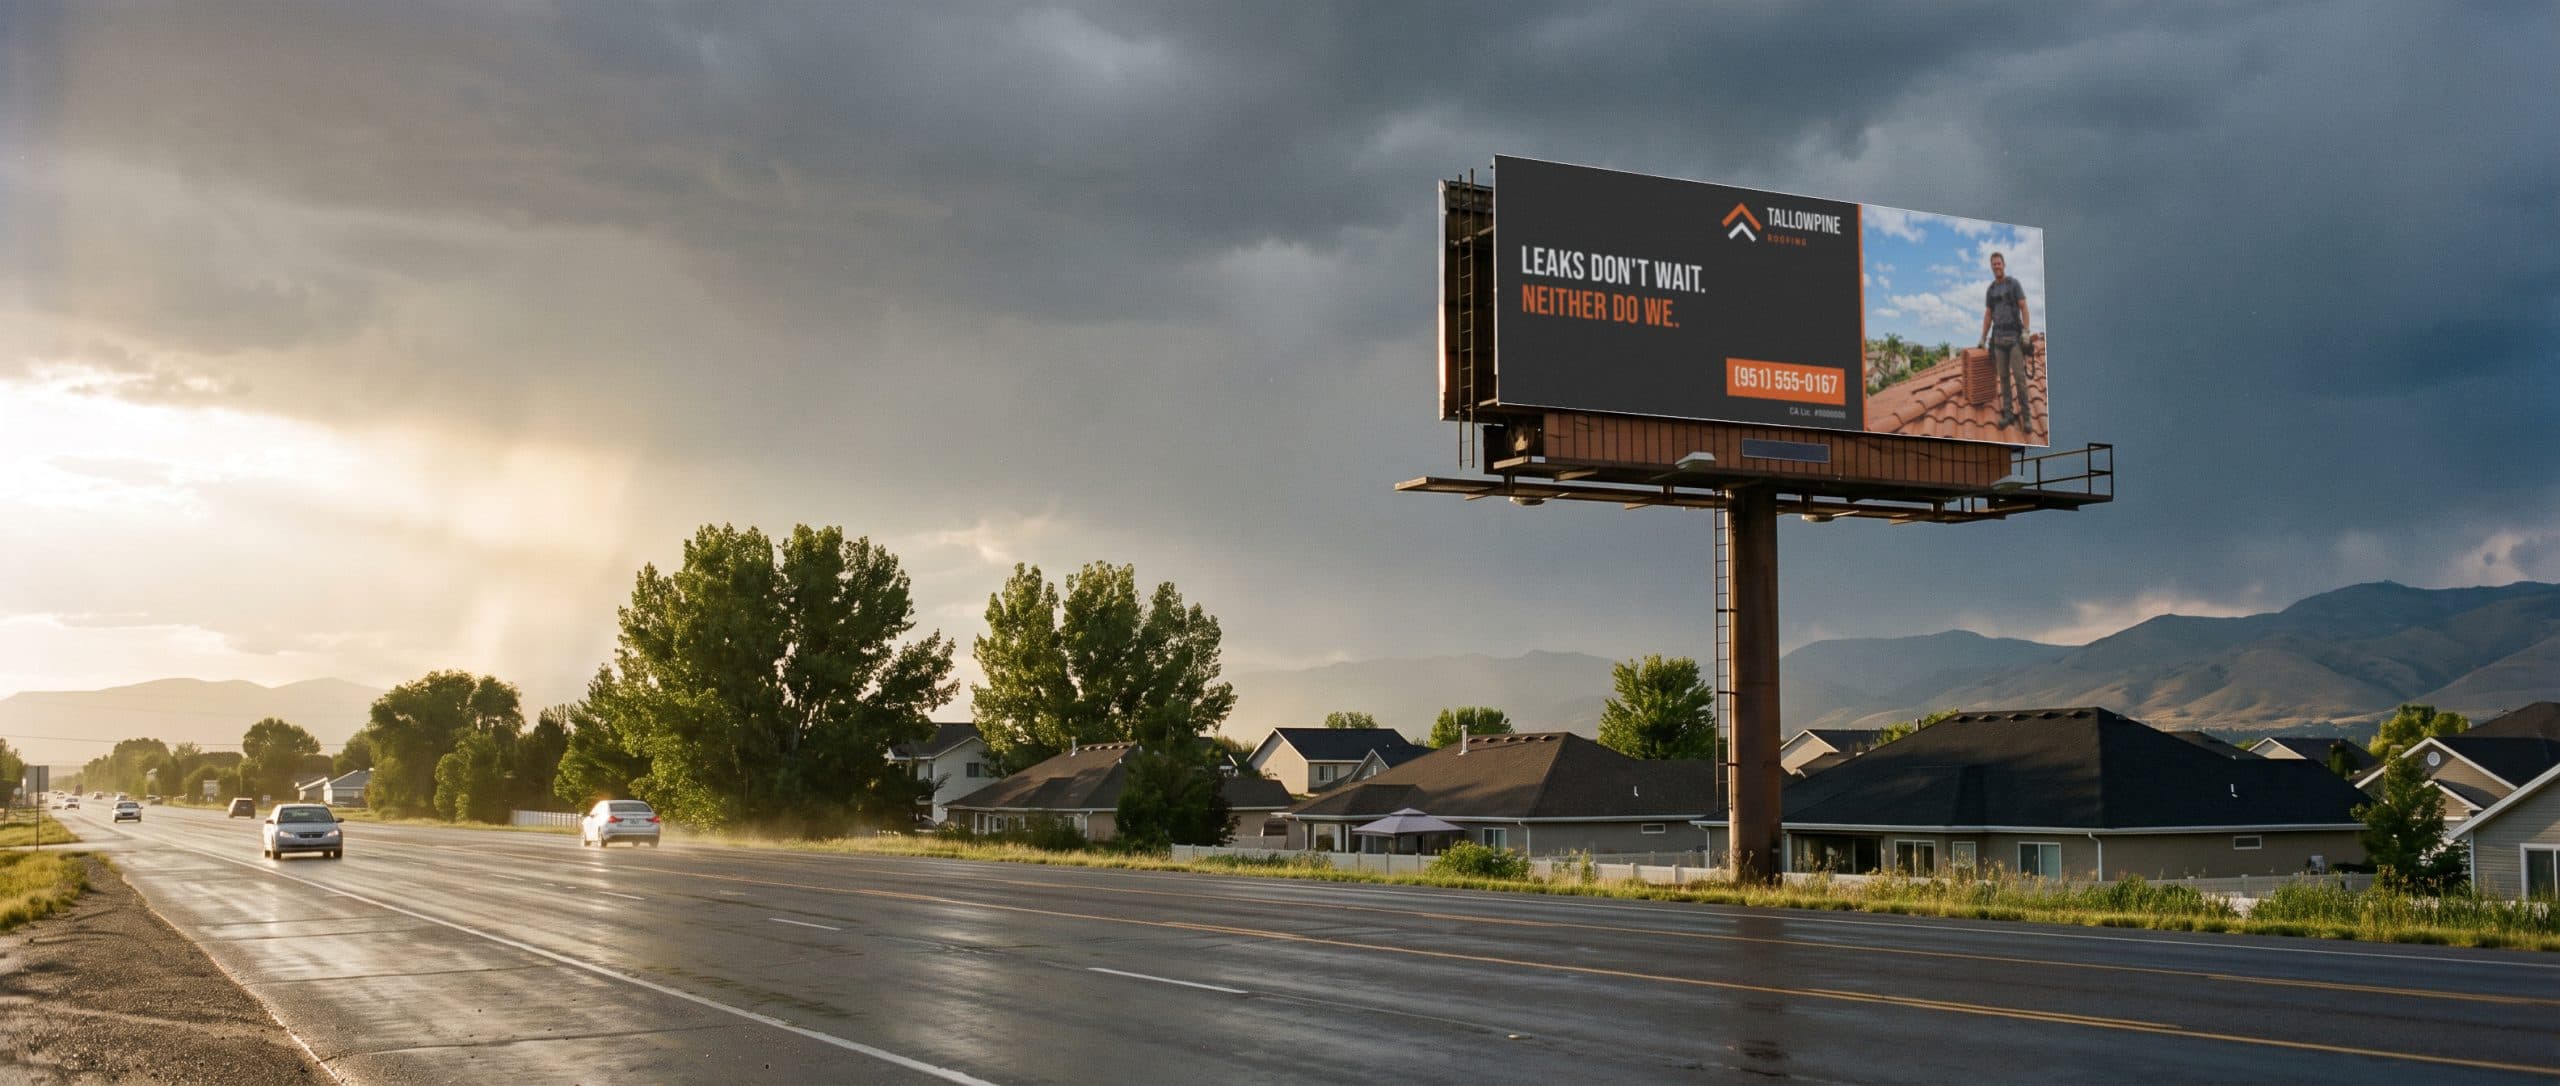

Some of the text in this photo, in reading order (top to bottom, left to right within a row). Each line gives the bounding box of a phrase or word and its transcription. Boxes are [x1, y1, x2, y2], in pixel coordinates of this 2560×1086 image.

[1767, 207, 1841, 235] TALLOWPINE
[1767, 233, 1807, 246] ROOFING
[1521, 245, 1706, 294] LEAKS DON'T WAIT.
[1522, 284, 1680, 328] NEITHER DO WE.
[1734, 365, 1838, 395] (951) 555-0167
